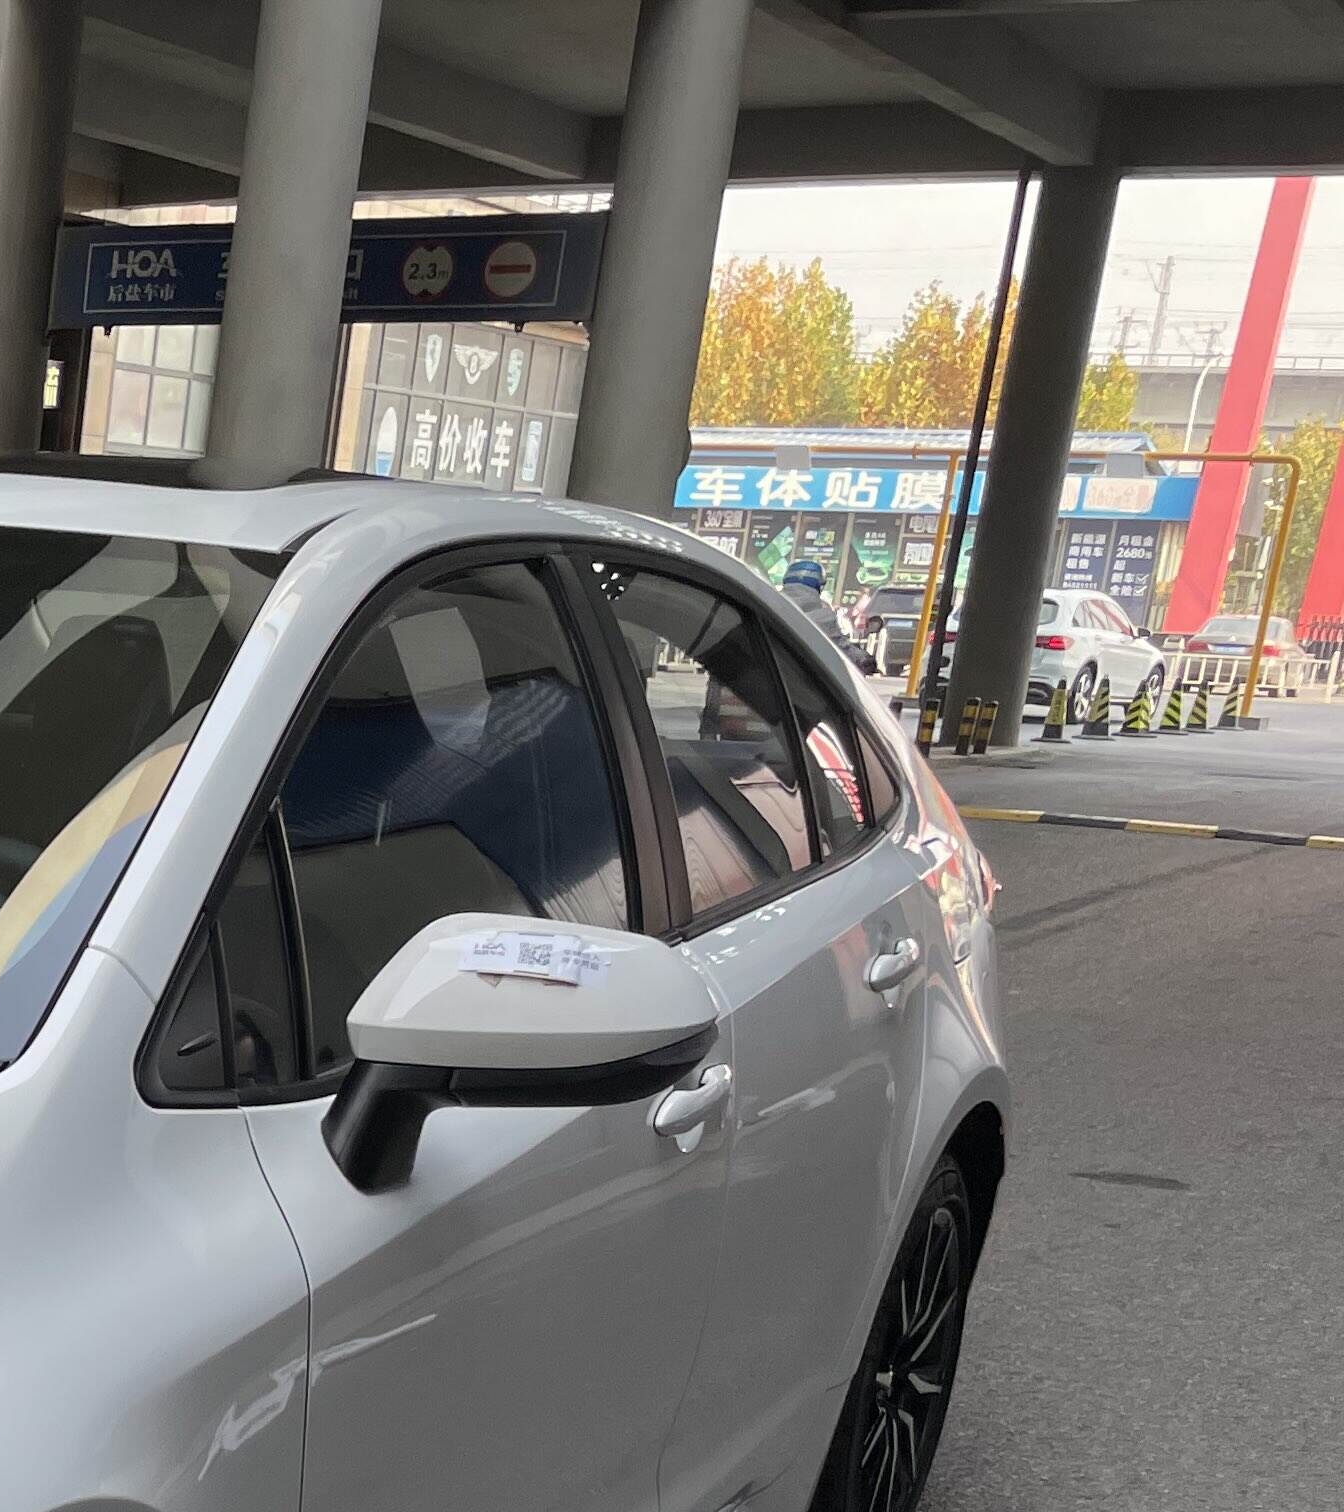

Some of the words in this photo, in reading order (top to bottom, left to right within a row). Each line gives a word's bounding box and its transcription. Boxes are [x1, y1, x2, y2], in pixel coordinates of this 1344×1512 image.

[109, 248, 178, 281] HOA
[408, 262, 449, 280] 2.3m
[410, 408, 514, 479] 高价收车
[689, 468, 948, 509] 车体贴膜
